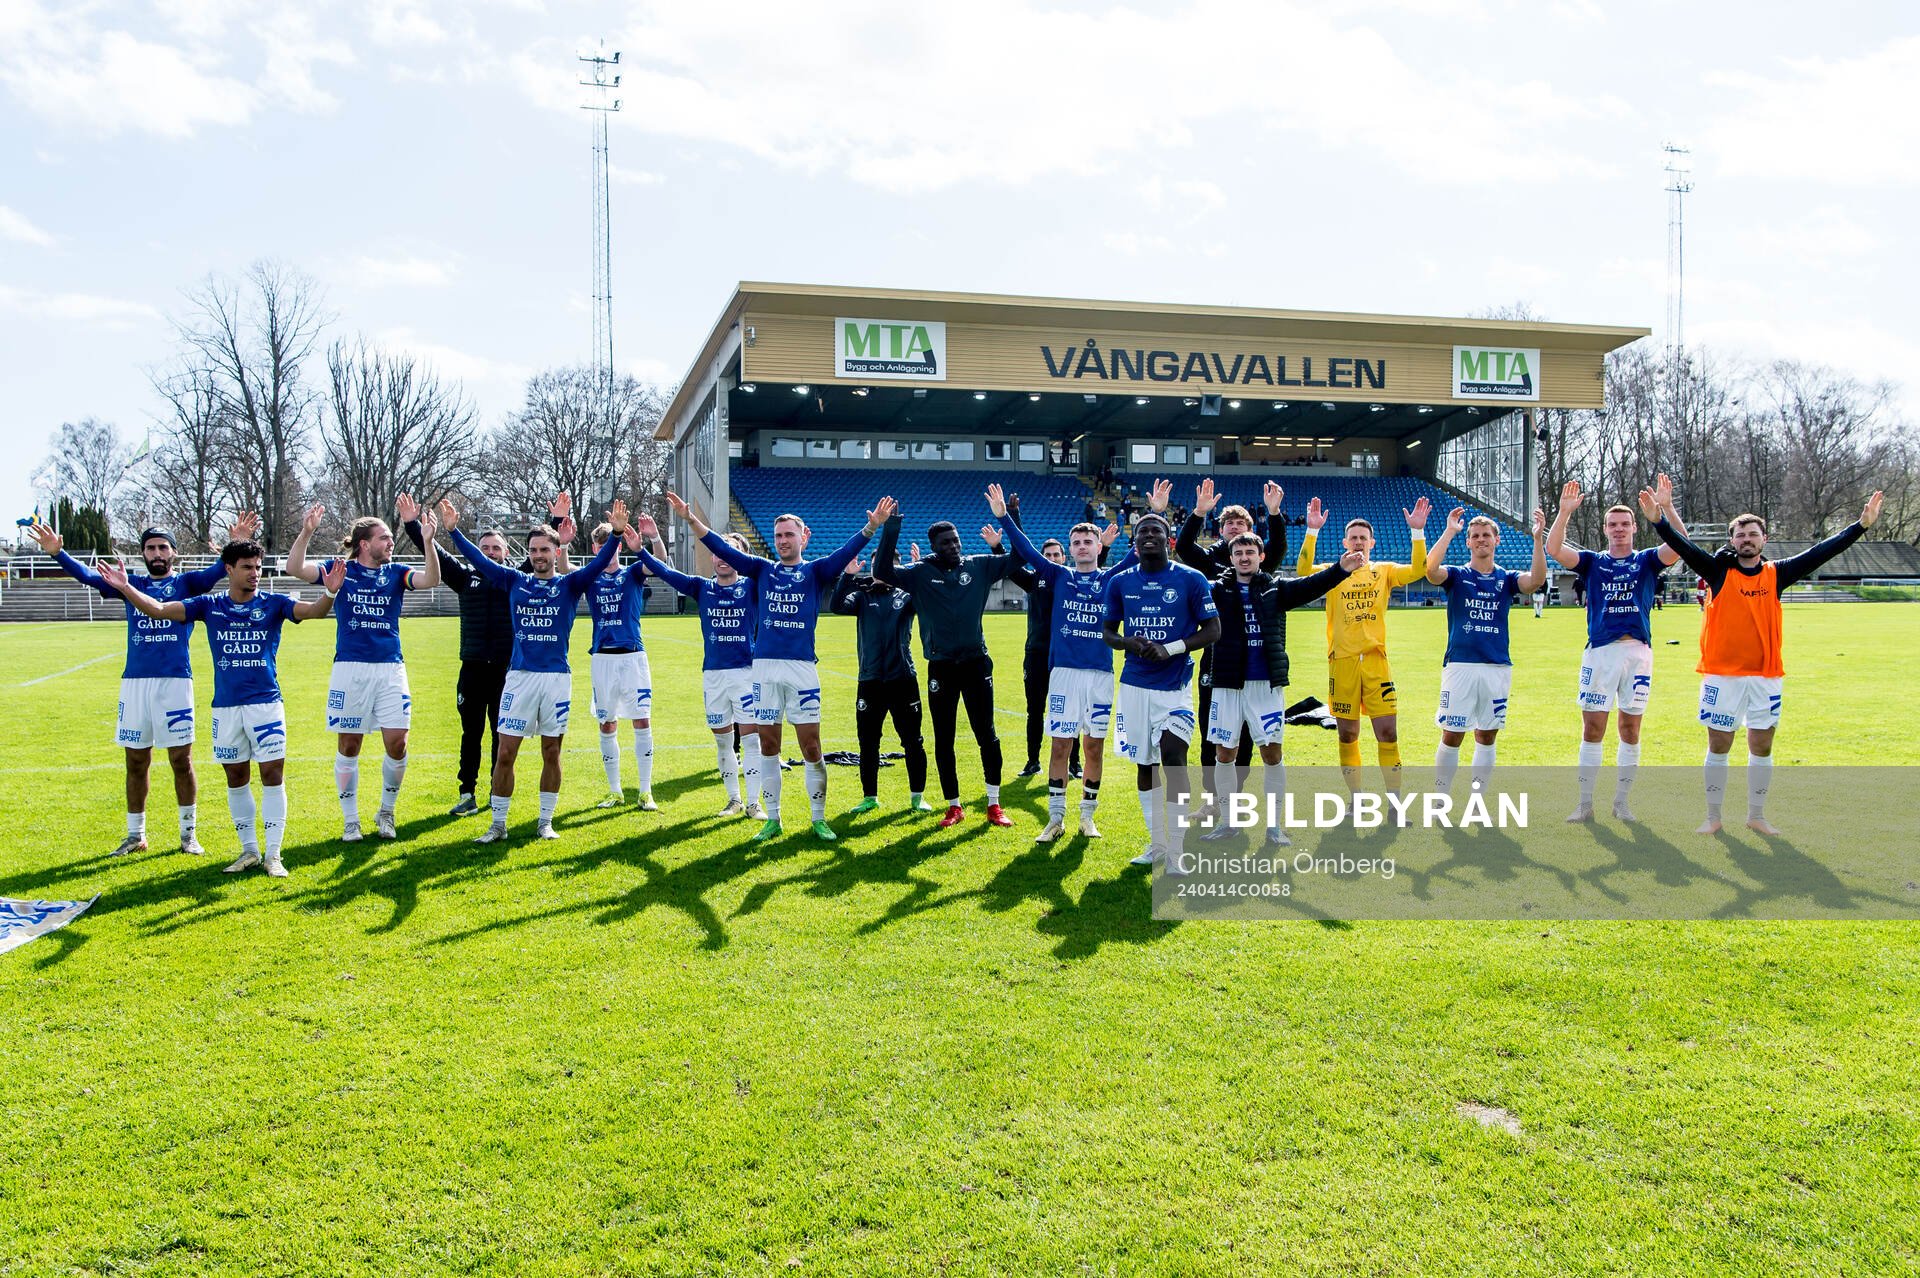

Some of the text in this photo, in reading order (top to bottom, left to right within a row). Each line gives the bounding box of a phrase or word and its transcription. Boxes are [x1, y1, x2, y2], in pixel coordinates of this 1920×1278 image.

[845, 323, 936, 361] MTA
[846, 362, 867, 371] Bygg
[1040, 338, 1386, 389] VÅNGAVALLEN
[1461, 351, 1530, 382] MTA
[1461, 385, 1479, 393] Bygg
[347, 592, 392, 606] MELLBY
[765, 590, 805, 603] MELLBY
[1604, 591, 1633, 601] GÅRD
[352, 604, 385, 616] GÅRD
[516, 605, 560, 616] MELLBY
[707, 607, 746, 617] MELLBY
[768, 602, 799, 614] GÅRD
[1062, 600, 1104, 613] MELLBY
[137, 617, 172, 629] GÅRD
[520, 616, 553, 627] GÅRD
[711, 617, 740, 628] GÅRD
[1066, 611, 1098, 624] GÅRD
[1128, 616, 1176, 627] MELLBY
[216, 630, 268, 641] MELLBY
[223, 641, 261, 654] GÅRD
[1586, 692, 1607, 700] INTER
[1586, 698, 1606, 706] SPORT
[1712, 712, 1735, 721] INTER
[1711, 719, 1733, 727] SPORT
